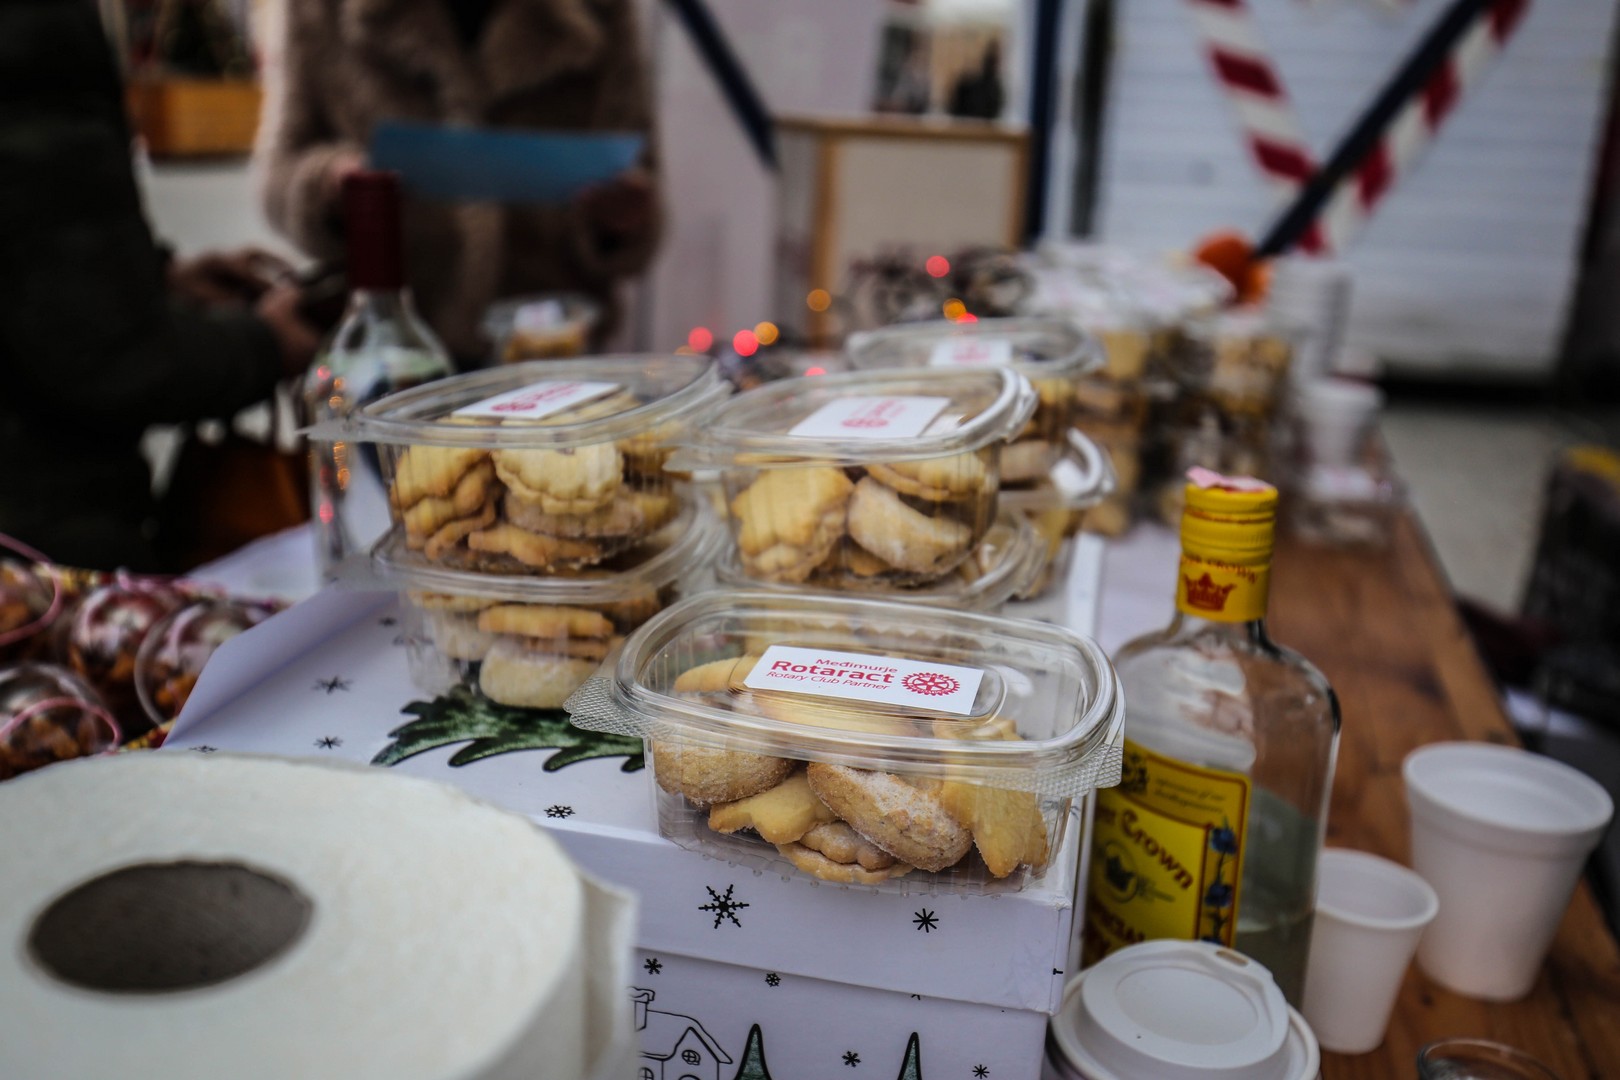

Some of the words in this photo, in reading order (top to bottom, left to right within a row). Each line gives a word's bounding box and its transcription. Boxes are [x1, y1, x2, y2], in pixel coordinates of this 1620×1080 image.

[766, 671, 807, 683] Rotary
[810, 674, 840, 685] Club
[842, 679, 890, 691] Partner
[770, 660, 895, 684] Rotaract
[1120, 808, 1194, 890] Crown
